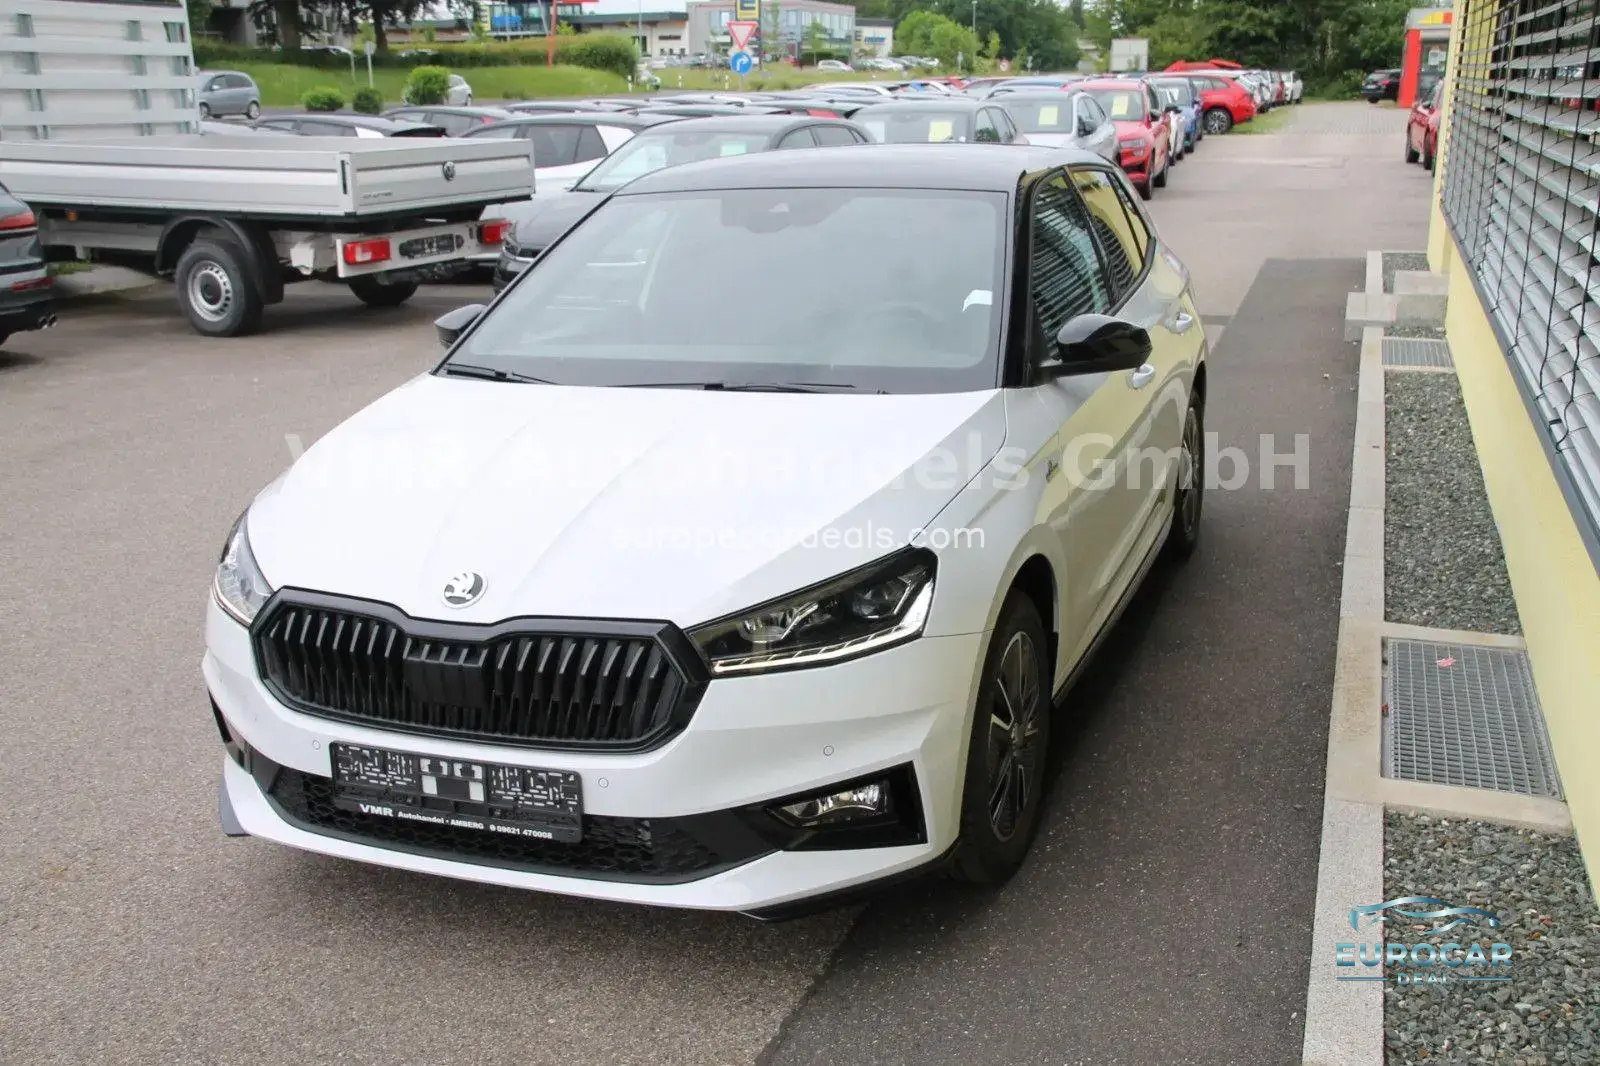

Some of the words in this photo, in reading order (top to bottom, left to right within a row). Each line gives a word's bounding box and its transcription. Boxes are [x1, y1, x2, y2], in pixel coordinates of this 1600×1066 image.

[359, 803, 393, 817] VMR
[398, 811, 444, 824] Autohandel
[451, 819, 484, 829] AMBERG
